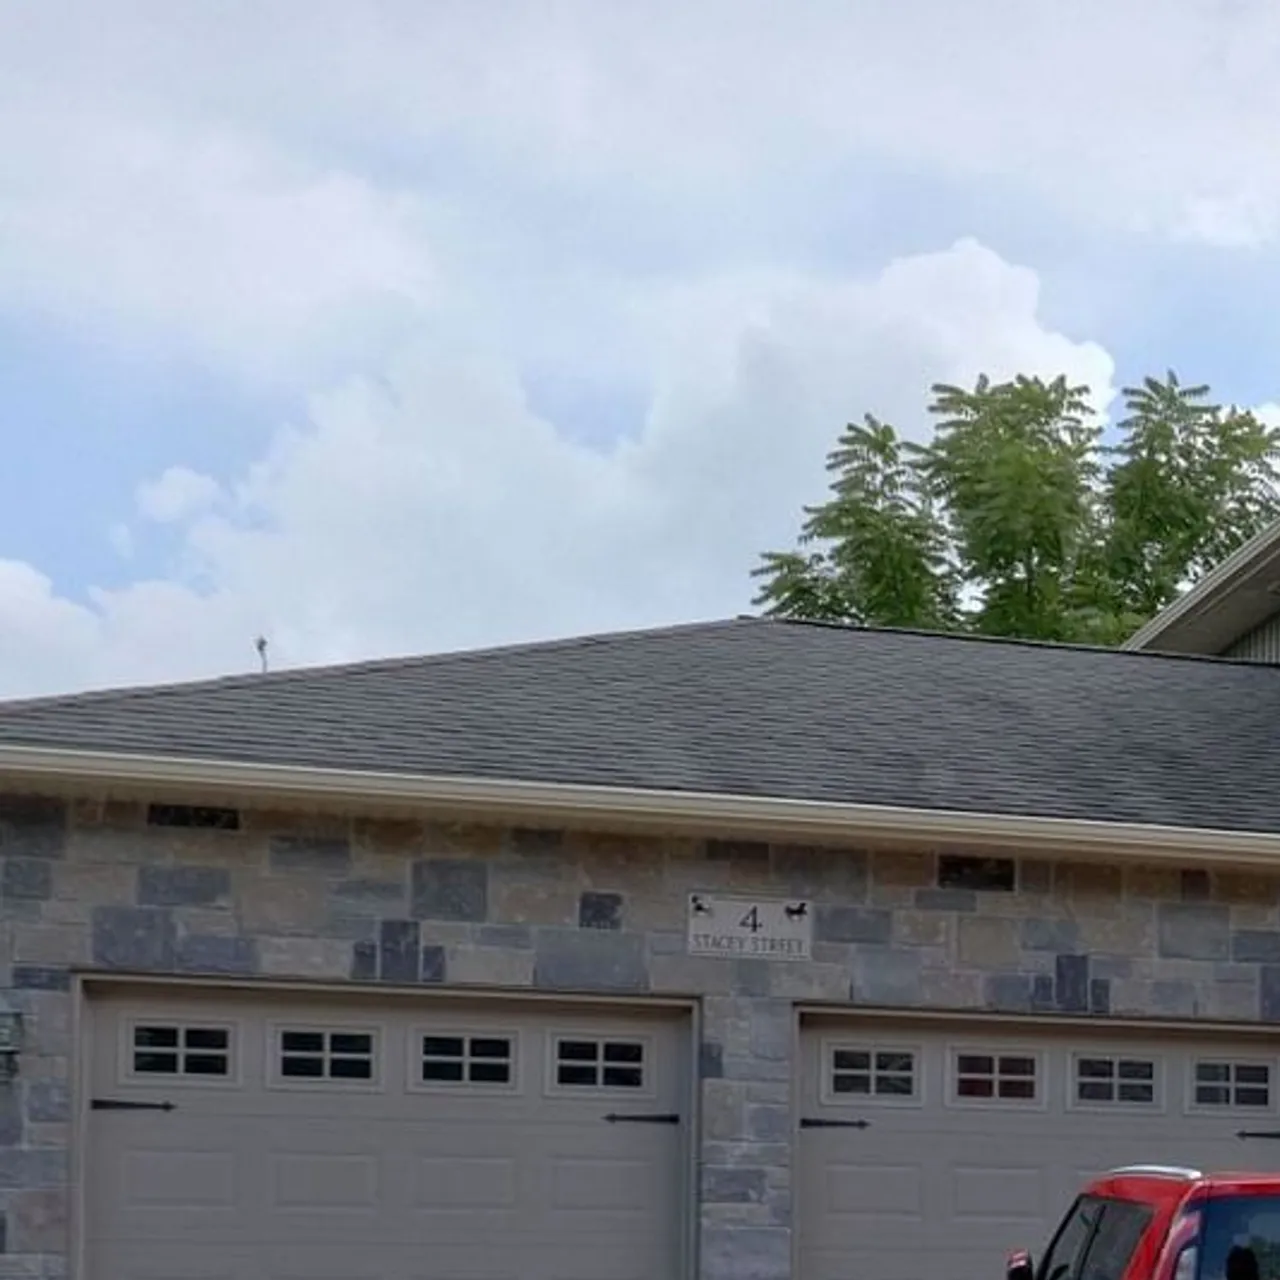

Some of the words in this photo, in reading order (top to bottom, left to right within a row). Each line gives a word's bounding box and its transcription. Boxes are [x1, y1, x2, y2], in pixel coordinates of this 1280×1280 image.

[738, 905, 764, 933] 4
[693, 934, 745, 950] STACEY
[751, 936, 805, 953] STREET
